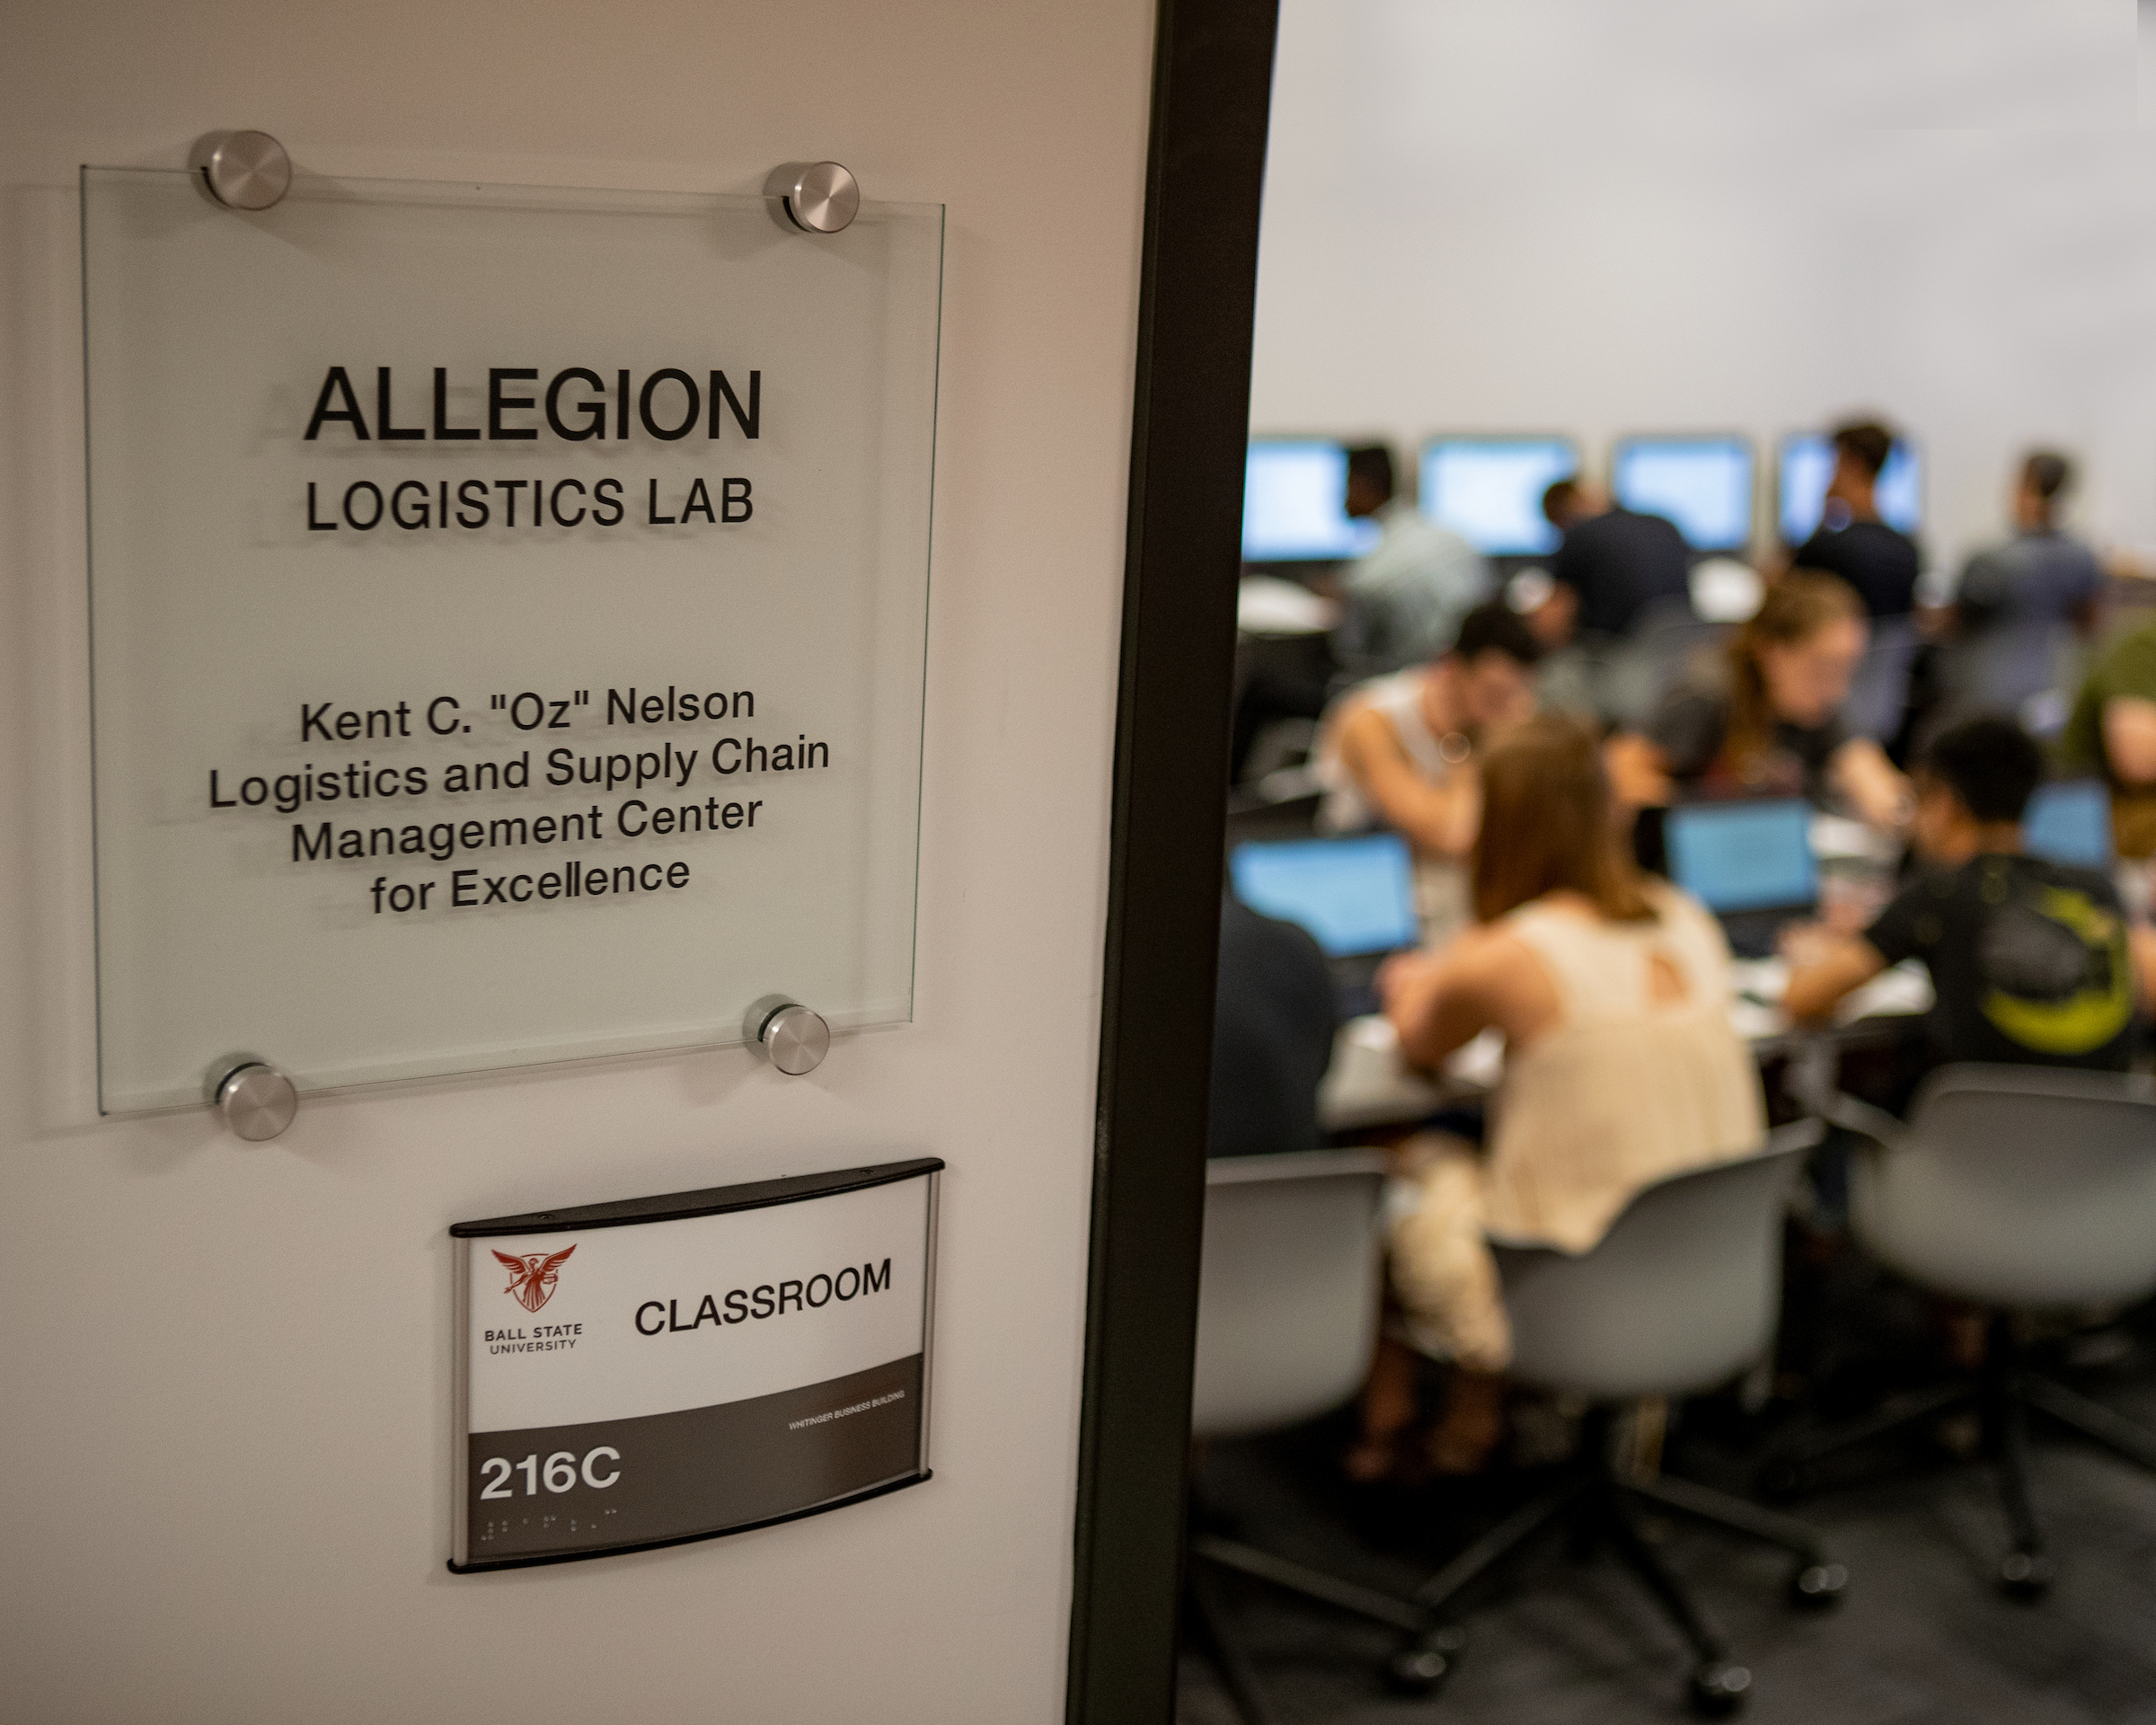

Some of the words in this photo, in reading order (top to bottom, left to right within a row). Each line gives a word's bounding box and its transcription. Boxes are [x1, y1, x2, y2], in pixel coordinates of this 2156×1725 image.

[304, 367, 762, 441] ALLEGION
[306, 478, 625, 530] LOGISTICS
[648, 477, 755, 525] LAB
[301, 700, 411, 742] Kent
[427, 695, 472, 735] C.
[490, 689, 590, 731] "Oz"
[606, 686, 755, 725] Nelson
[208, 760, 429, 813] Logistics
[444, 751, 530, 793] and
[545, 742, 698, 788] Supply
[711, 734, 830, 776] Chain
[291, 805, 603, 862] Management
[618, 797, 763, 839] Center
[370, 877, 436, 914] for
[451, 861, 691, 907] Excellence
[634, 1258, 891, 1336] CLASSROOM
[485, 1329, 526, 1341] BALL
[534, 1323, 582, 1338] STATE
[490, 1339, 576, 1355] UNIVERSITY
[789, 1412, 833, 1430] WHITINGER
[834, 1402, 871, 1419] BUSINESS
[872, 1390, 905, 1407] BUILDING
[480, 1446, 621, 1499] 216C
